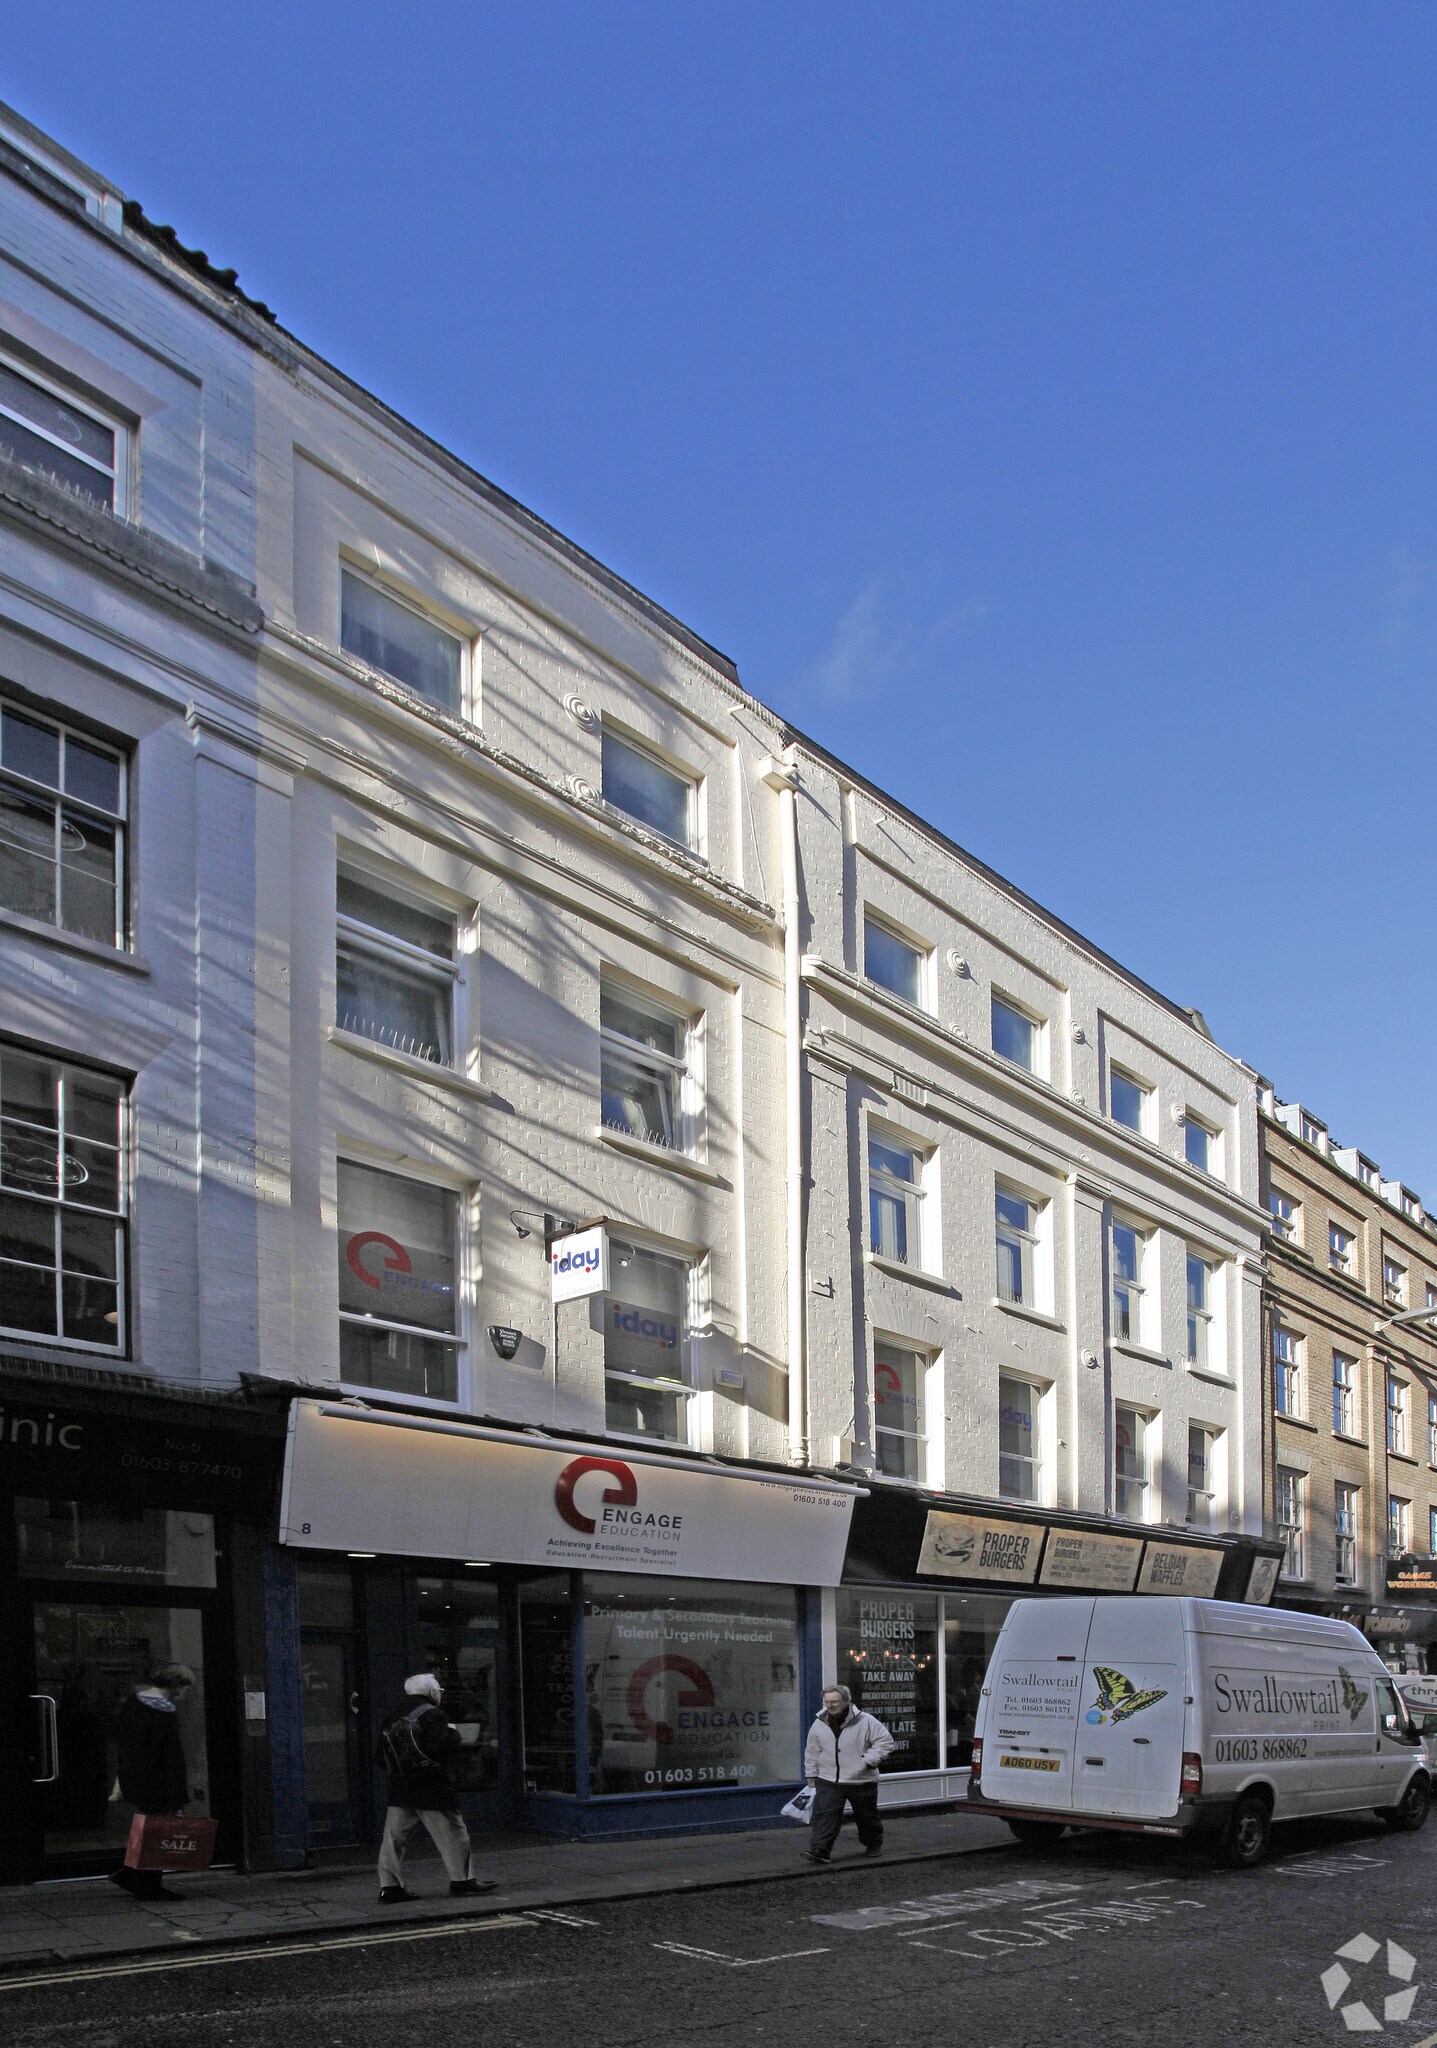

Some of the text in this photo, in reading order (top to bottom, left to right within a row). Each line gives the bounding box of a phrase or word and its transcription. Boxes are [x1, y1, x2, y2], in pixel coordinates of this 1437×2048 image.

[553, 1247, 600, 1275] iday
[614, 1304, 678, 1348] iday
[121, 1454, 170, 1471] 01603
[793, 1494, 847, 1508] 01603 518 400
[602, 1508, 683, 1529] ENGAGE
[302, 1523, 311, 1535] 8
[601, 1524, 681, 1541] EDUCATION
[548, 1538, 678, 1557] Achieving Excellence Together
[983, 1532, 1029, 1554] PROPER
[1056, 1537, 1083, 1550] PROPER
[547, 1549, 676, 1566] Education Recruitment Specialist
[980, 1550, 1027, 1571] BURGERS
[1054, 1548, 1081, 1560] BURGERS
[1153, 1553, 1188, 1571] BELGIAN
[1150, 1568, 1185, 1586] WAFFLES
[1398, 1571, 1432, 1580] GAMES
[590, 1604, 649, 1622] Primary
[652, 1608, 663, 1621] &
[667, 1609, 736, 1627] Secondary
[860, 1601, 914, 1620] PROPER
[616, 1625, 773, 1643] Talent Urgently Needed
[860, 1620, 915, 1639] BURGERS
[860, 1639, 915, 1654] BELGIAN
[862, 1656, 916, 1671] WAFFLES
[861, 1671, 915, 1682] TAKE AWAY
[1002, 1672, 1079, 1688] Swallowtail
[861, 1691, 916, 1700] BREAKFAST EVERYDAY
[1021, 1696, 1042, 1704] 01603
[1043, 1698, 1071, 1706] 868862
[1215, 1673, 1340, 1715] Swallowtail
[1022, 1704, 1043, 1712] 01603
[1045, 1706, 1071, 1714] 861371
[678, 1711, 771, 1729] ENGAGE
[893, 1720, 917, 1733] LATE
[1313, 1719, 1341, 1731] PRINT
[679, 1731, 771, 1745] EDUCATION
[998, 1728, 1031, 1736] TRANSIT
[1216, 1739, 1257, 1762] 01603
[1263, 1738, 1308, 1760] 868862
[1004, 1757, 1056, 1771] AO60 USV
[645, 1765, 756, 1784] 01603 518 400
[160, 1838, 197, 1850] SALE
[908, 1896, 1207, 1959] LOADING
